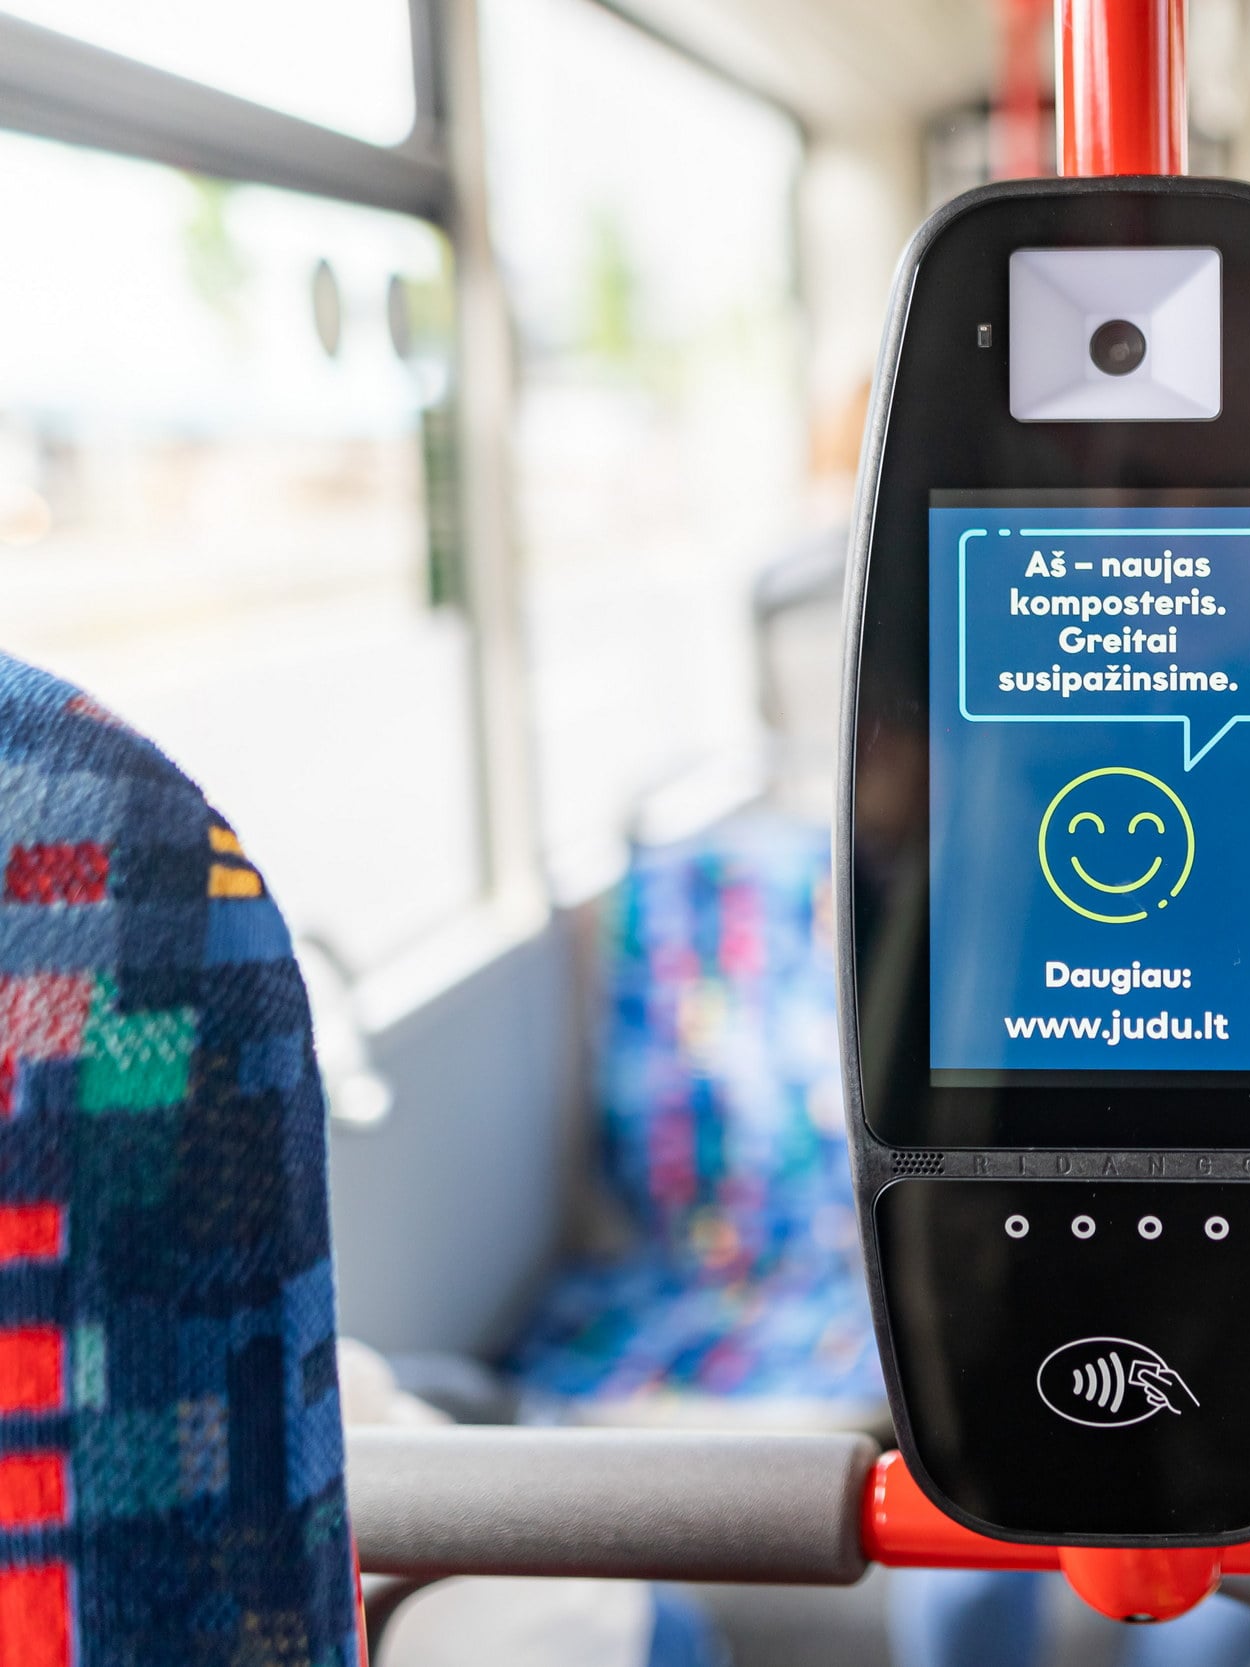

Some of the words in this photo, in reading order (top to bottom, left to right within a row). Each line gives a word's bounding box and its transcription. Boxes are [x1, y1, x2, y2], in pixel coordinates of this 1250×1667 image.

[1024, 550, 1067, 578] Aš
[1101, 549, 1211, 584] naujas
[1010, 587, 1226, 622] komposteris.
[1058, 625, 1177, 654] Greitai
[998, 663, 1238, 698] susipažinsime.
[1045, 960, 1192, 995] Daugiau:
[1004, 1009, 1229, 1046] www.judu.lt
